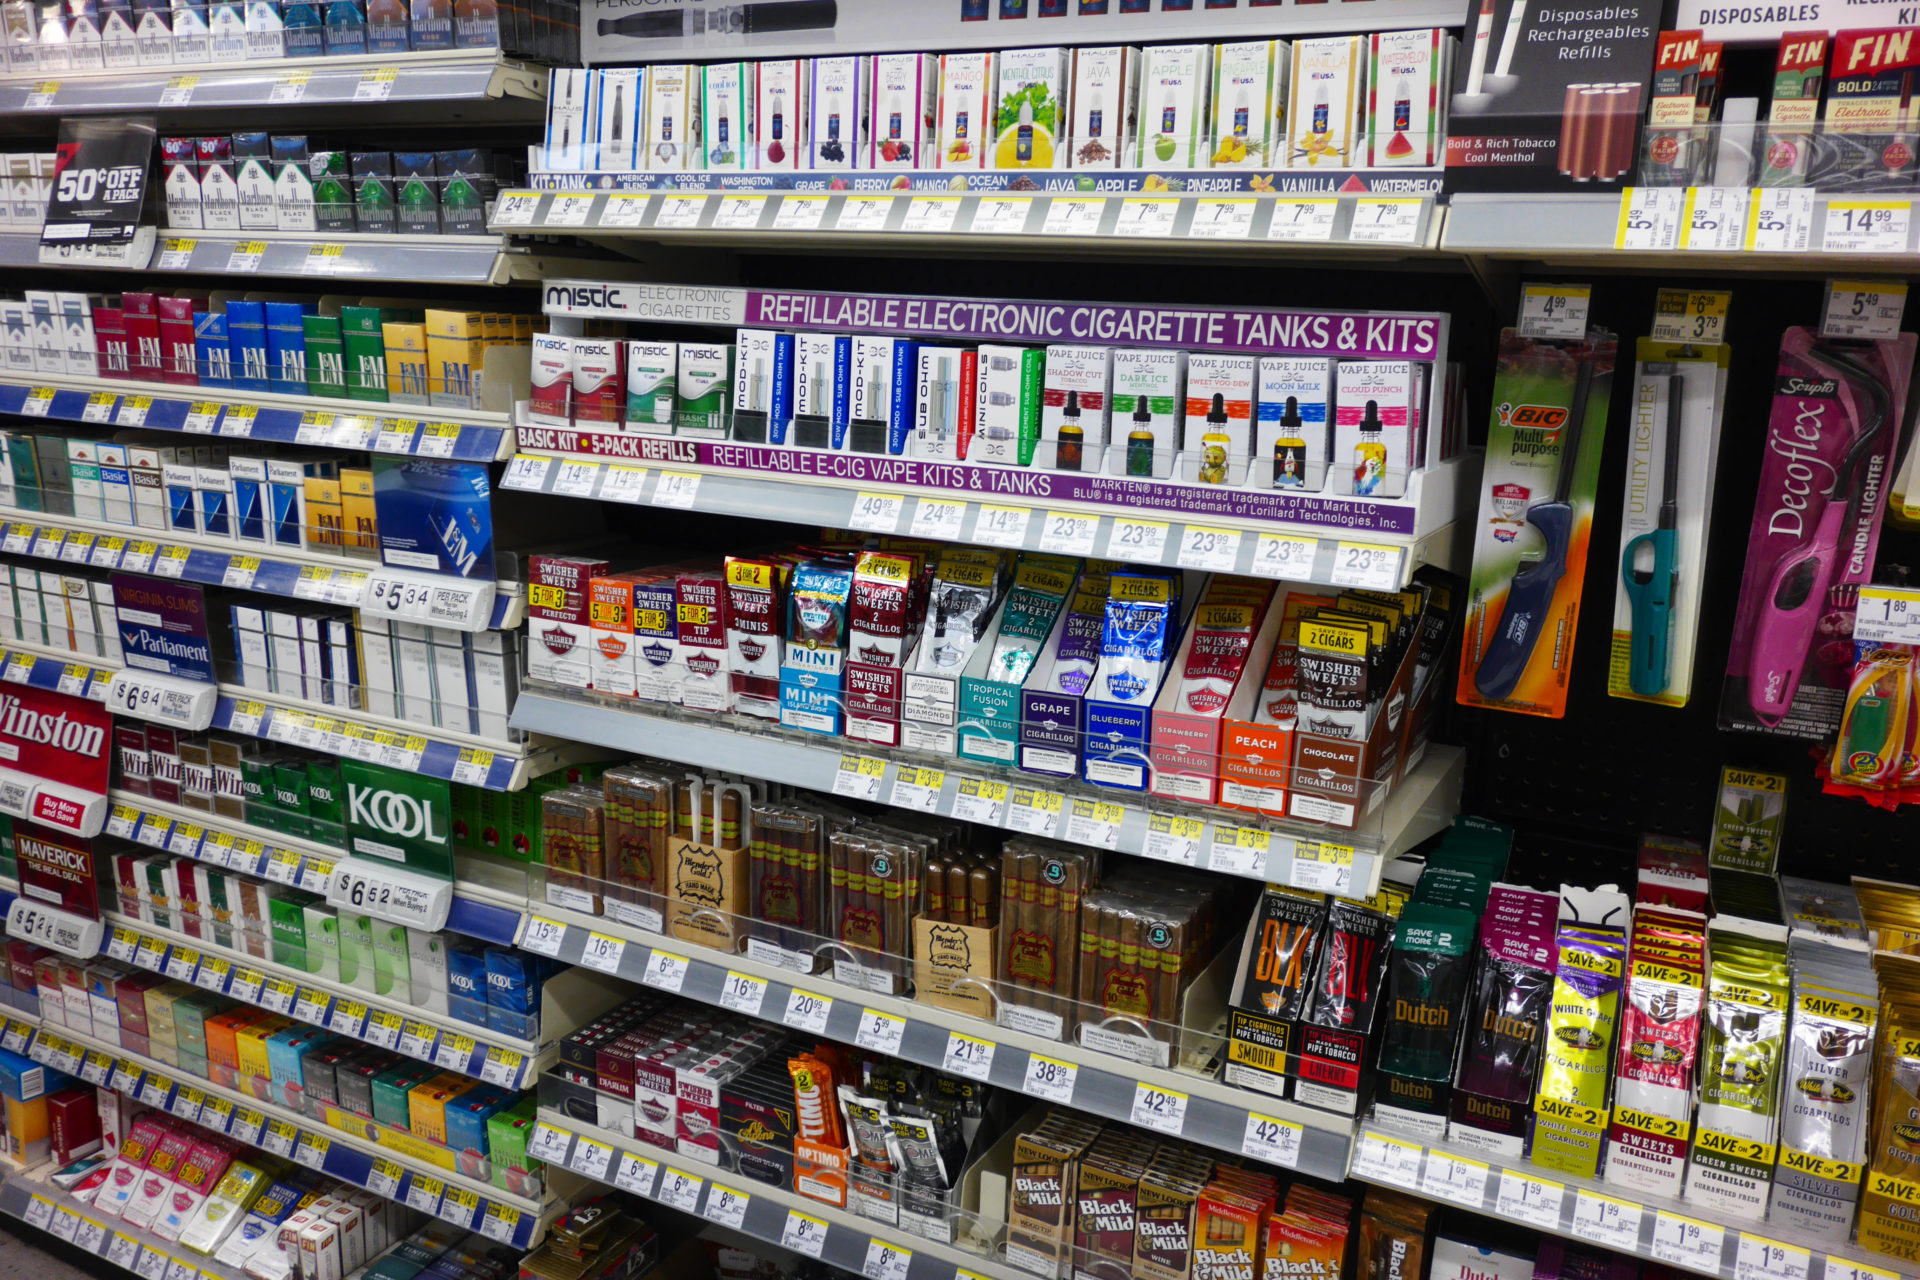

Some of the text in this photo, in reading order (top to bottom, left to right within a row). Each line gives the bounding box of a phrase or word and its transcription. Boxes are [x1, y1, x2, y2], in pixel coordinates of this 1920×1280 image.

[1539, 6, 1639, 23] Disposables
[1700, 4, 1819, 25] DISPOSABLES
[1528, 25, 1649, 42] Rechargeables
[1558, 45, 1611, 59] Refills
[1661, 39, 1699, 65] FIN
[1848, 31, 1913, 70] FIN
[1086, 67, 1110, 78] JAVA
[1152, 65, 1193, 76] APPLE
[1838, 81, 1871, 93] BOLD
[1448, 137, 1556, 149] Bold & Rich Tobacco
[1465, 152, 1535, 163] Cool Menthol
[721, 177, 772, 186] WASHINGTON
[795, 181, 825, 190] GRAPE
[855, 179, 889, 190] BERRY
[916, 180, 948, 191] MANGO
[968, 175, 1008, 186] OCEAN
[1187, 179, 1241, 191] PINEAPPLE
[1283, 178, 1335, 191] VANILLA
[103, 189, 140, 200] A PACK
[639, 286, 732, 303] ELECTRONIC
[639, 303, 731, 320] CIGARETTES
[760, 294, 1434, 352] REFILLABLE ELECTRONIC CIGARETTE TANKS & KITS
[1048, 349, 1105, 360] VAPE JUICE
[1115, 353, 1175, 364] VAPE JUICE
[739, 333, 749, 407] MOD-KIT
[1048, 368, 1083, 376] SHADOW
[1120, 374, 1168, 383] DARK ICE
[1781, 378, 1834, 394] Scripto
[1265, 382, 1320, 391] MOON MILK
[1514, 429, 1544, 442] Multi
[518, 428, 695, 462] BASIC KIT 5-PACK REFILLS
[1512, 442, 1559, 457] purpose
[1630, 384, 1655, 513] UTILITY LIGHTER
[232, 461, 259, 474] Parliament
[713, 447, 1051, 496] REFILLABLE E-CIG VAPE KITS & TANKS
[1769, 401, 1839, 538] Decoflex
[101, 468, 126, 483] Basic
[134, 474, 159, 487] Basic
[1092, 479, 1150, 492] MARKTEN®
[1154, 486, 1162, 494] is
[1176, 488, 1228, 501] registered
[1232, 492, 1286, 506] trademark
[1289, 497, 1300, 507] of
[1304, 498, 1319, 509] Nu
[1323, 499, 1349, 513] Mark
[1354, 502, 1380, 515] LLC.
[1073, 488, 1400, 528] BLU® registered trademark of Lorillard Technologies, Inc.
[1850, 454, 1884, 574] CANDLE LIGHTER
[540, 563, 578, 578] SWISHER
[541, 575, 577, 589] SWEETS
[533, 586, 562, 608] 5 FOR 3
[542, 609, 576, 621] PERFECTO
[694, 626, 709, 634] TIP
[140, 629, 208, 662] Parliament
[682, 636, 722, 645] CIGARILLOS
[1310, 632, 1354, 649] 2 CIGARS
[793, 649, 834, 666] MINI
[1301, 657, 1361, 676] SWISHER
[850, 670, 892, 685] SWISHER
[1304, 669, 1357, 686] SWEETS
[852, 680, 890, 693] SWEETS
[968, 684, 1014, 698] TROPICAL
[849, 700, 891, 713] CIGARILLOS
[973, 695, 1008, 707] FUSION
[907, 708, 950, 720] DIAMONDS
[1031, 703, 1070, 715] GRAPE
[1091, 715, 1141, 727] BLUEBERRY
[1159, 727, 1209, 739] STRAWBERRY
[1236, 736, 1277, 749] PEACH
[1304, 748, 1354, 762] CHOCOLATE
[1298, 776, 1354, 792] CIGARILLOS
[1728, 772, 1776, 789] SAVE 2
[43, 797, 78, 815] Buy More
[347, 783, 447, 844] KOOL
[42, 807, 75, 823] and Save
[21, 838, 85, 872] MAVERICK
[685, 857, 715, 871] Blender's
[28, 861, 82, 883] THE REAL DEAL
[700, 885, 714, 893] MADE
[1256, 919, 1313, 989] BLK
[1396, 1000, 1448, 1026] Dutch
[1236, 1030, 1283, 1047] PIPE TOBACCO
[1238, 1044, 1275, 1067] SMOOTH
[1391, 1079, 1432, 1099] Dutch
[1620, 1110, 1677, 1136] SAVE 2
[1622, 1133, 1674, 1155] SWEETS
[799, 1146, 839, 1167] OPTIMO
[1696, 1154, 1768, 1178] GREEN SWEETS
[1016, 1178, 1060, 1191] Black
[1793, 1176, 1840, 1196] SILVER
[1029, 1193, 1062, 1205] Mild
[1080, 1200, 1134, 1214] Black
[1096, 1217, 1134, 1231] Mild
[1151, 1254, 1171, 1265] WINE
